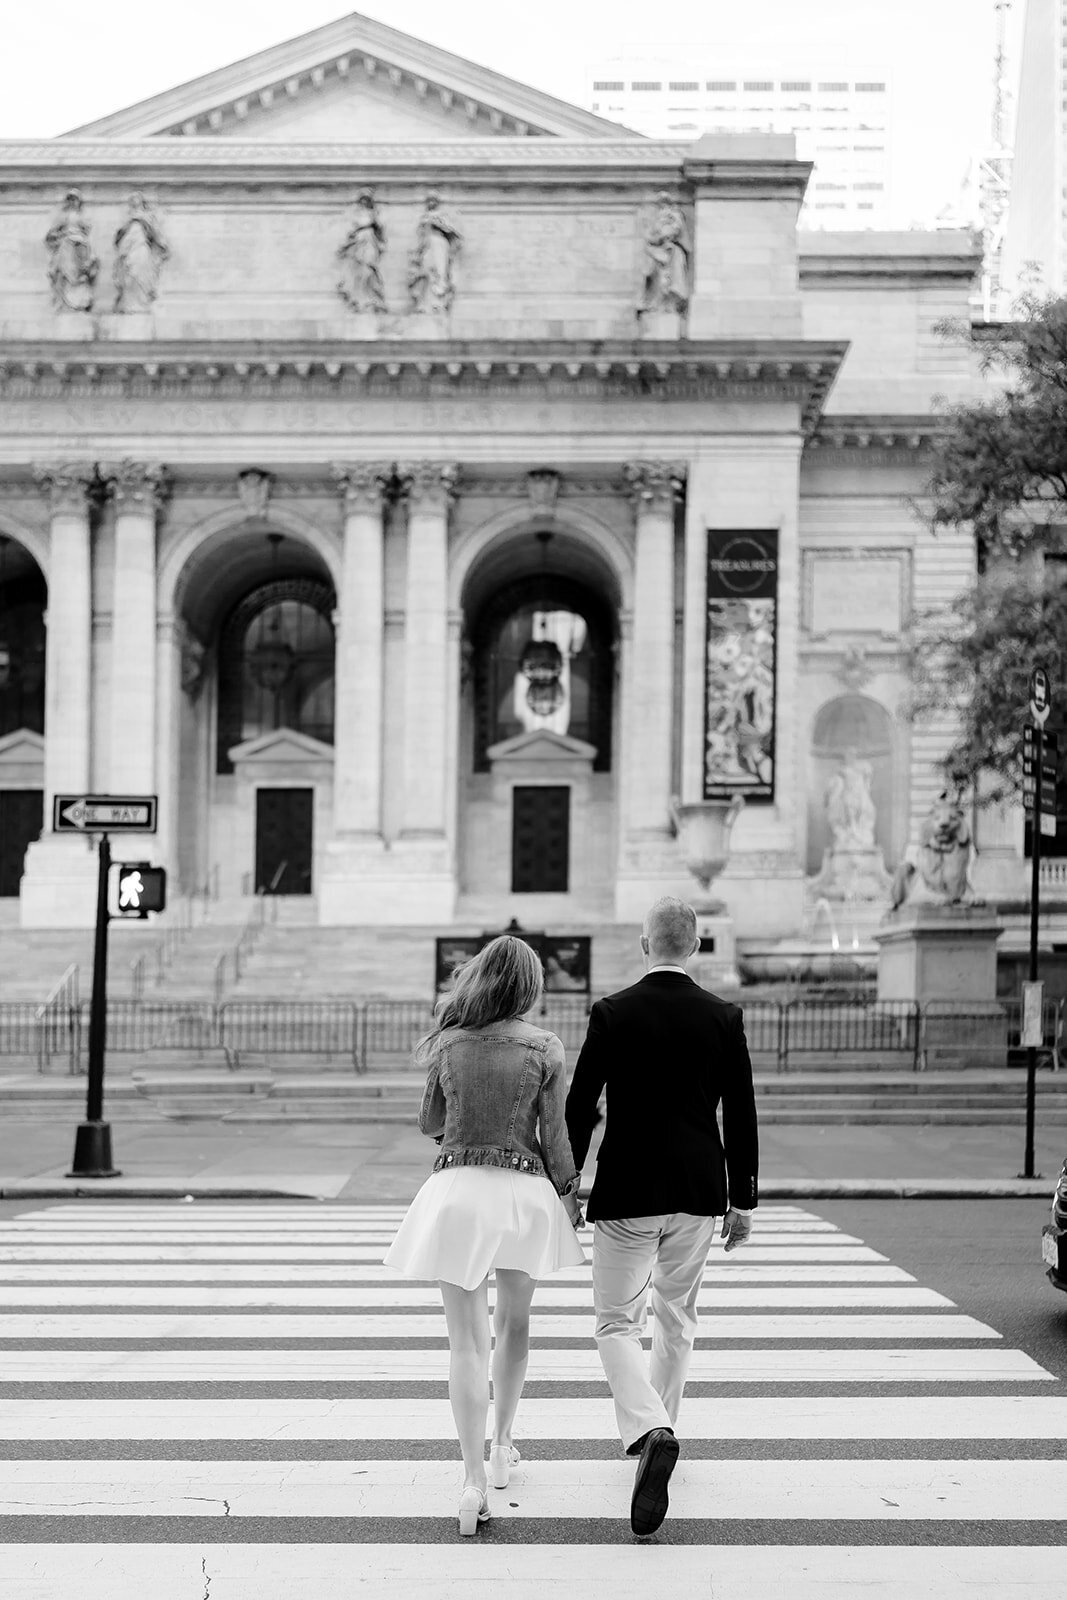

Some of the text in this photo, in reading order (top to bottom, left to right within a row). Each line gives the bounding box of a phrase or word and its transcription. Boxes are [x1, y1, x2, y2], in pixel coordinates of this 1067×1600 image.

[66, 405, 139, 427] NEW
[163, 405, 244, 427] YORK
[264, 405, 367, 427] PUBLC
[393, 405, 508, 427] LBRARY
[711, 559, 776, 571] TREASURES
[72, 807, 140, 822] ONE WAY
